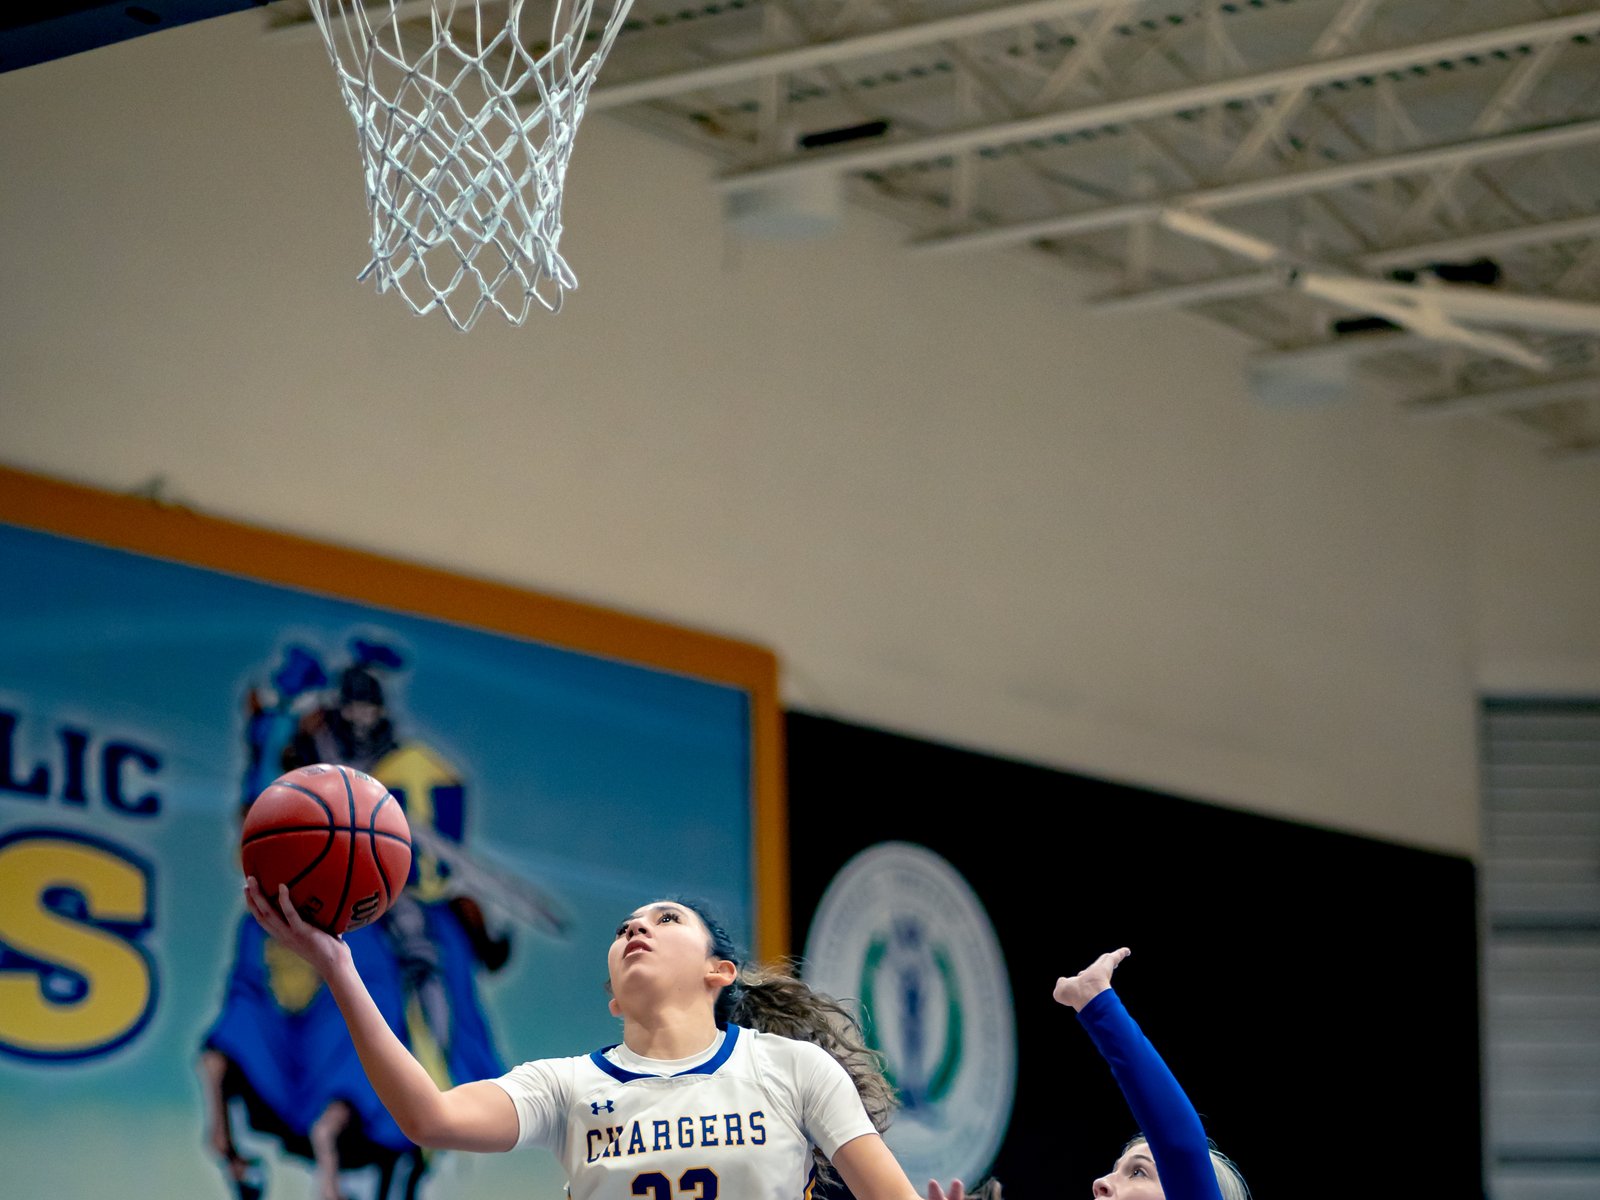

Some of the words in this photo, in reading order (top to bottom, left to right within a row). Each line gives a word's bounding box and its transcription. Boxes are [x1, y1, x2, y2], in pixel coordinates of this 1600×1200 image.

[0, 710, 161, 816] LIC
[0, 831, 158, 1060] S
[586, 1110, 767, 1164] CHARGERS
